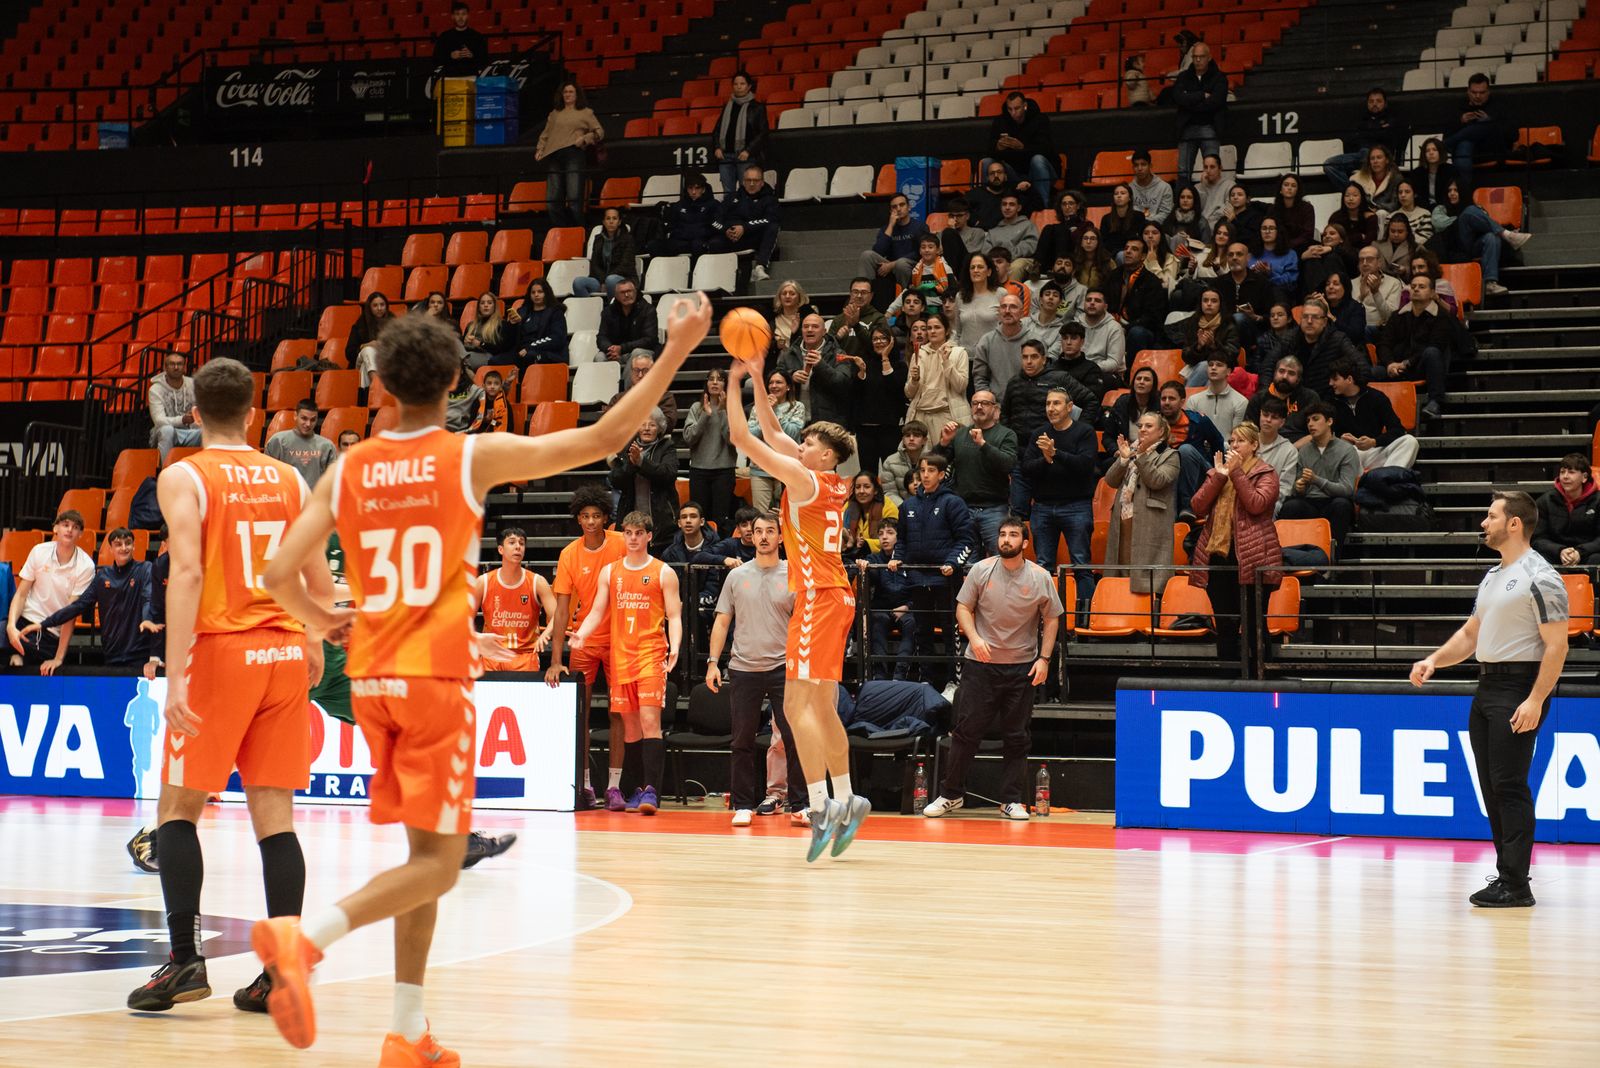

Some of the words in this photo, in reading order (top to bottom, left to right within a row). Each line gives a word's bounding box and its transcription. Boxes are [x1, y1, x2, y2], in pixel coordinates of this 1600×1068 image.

[216, 68, 321, 108] Coca-Cola
[1258, 111, 1299, 135] 112
[230, 147, 263, 167] 114
[673, 146, 708, 167] 113
[219, 464, 280, 485] TAZO
[362, 455, 436, 488] LAVILLE
[824, 511, 844, 553] 2
[359, 525, 443, 613] 30
[617, 592, 643, 600] Cultura
[617, 600, 650, 609] Esfuerzo
[491, 619, 530, 627] Esfuerzo
[626, 617, 635, 634] 7
[507, 633, 518, 648] 11
